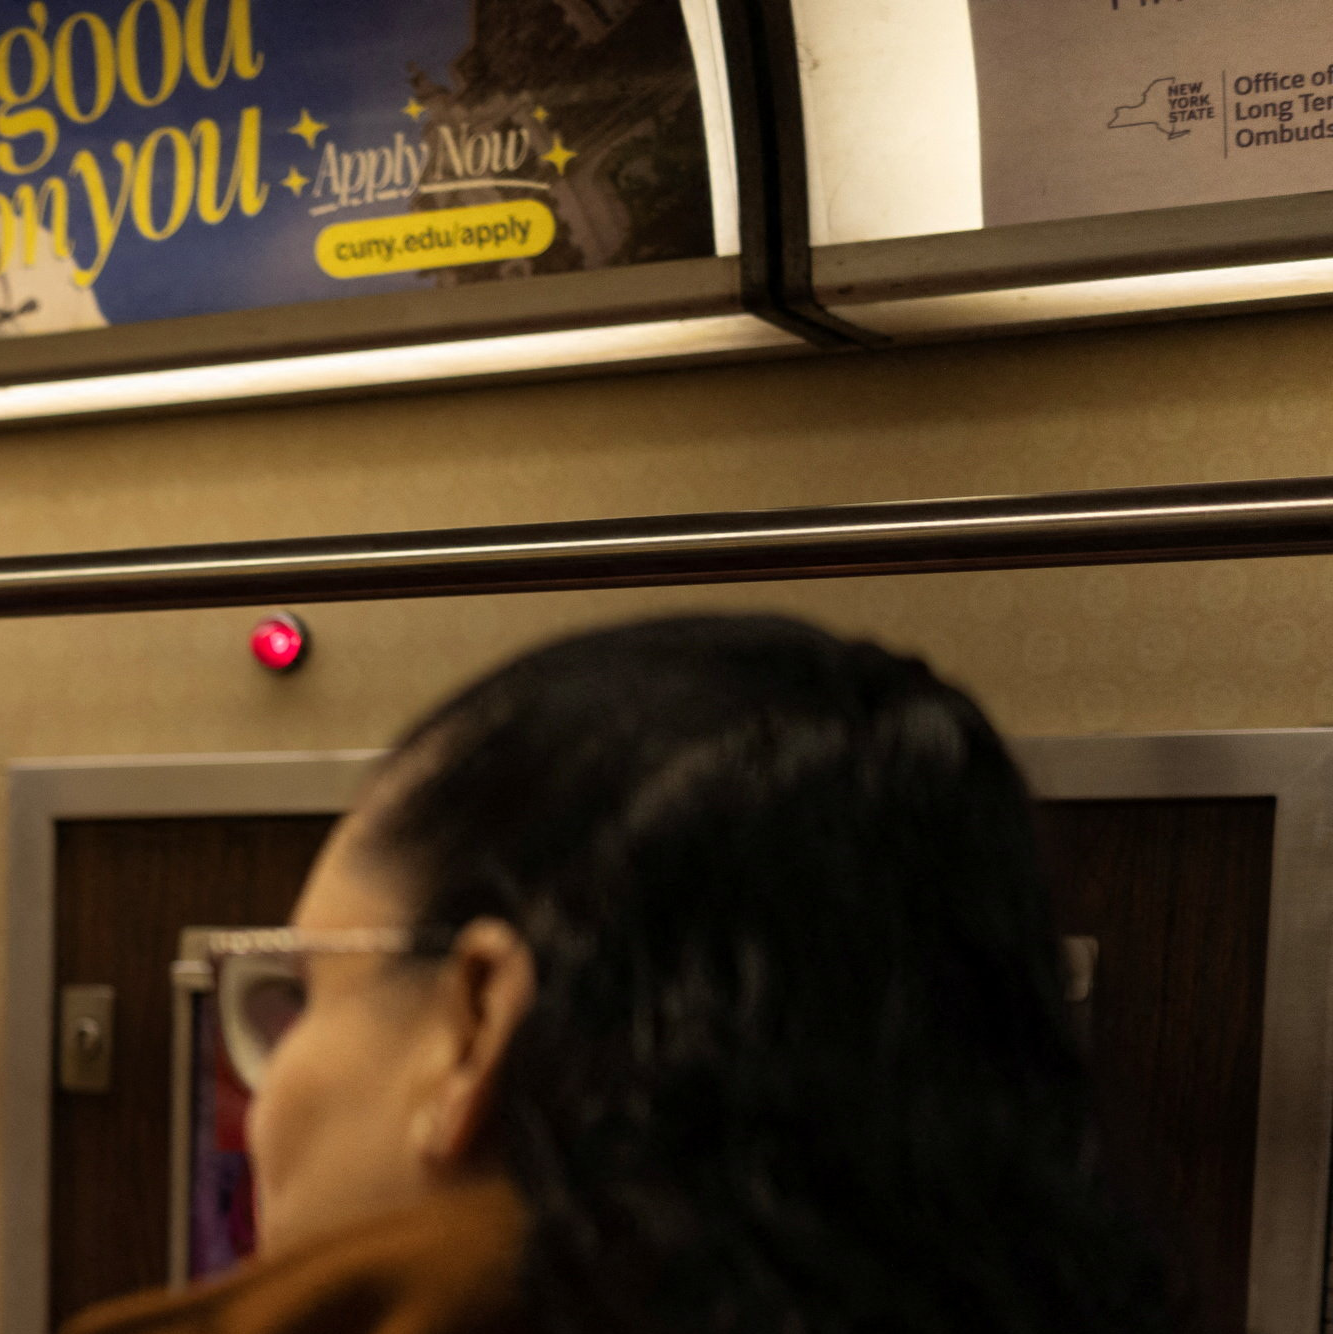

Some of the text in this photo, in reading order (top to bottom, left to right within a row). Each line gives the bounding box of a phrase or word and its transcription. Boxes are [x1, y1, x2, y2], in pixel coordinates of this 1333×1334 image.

[1168, 81, 1203, 97] NEW
[1234, 72, 1305, 96] Office
[1169, 95, 1210, 110] YORK
[1235, 99, 1293, 122] Long
[1168, 107, 1214, 123] STATE
[312, 122, 530, 207] Apply Now
[68, 106, 269, 287] you
[335, 214, 531, 262] cuny.edu/apply
